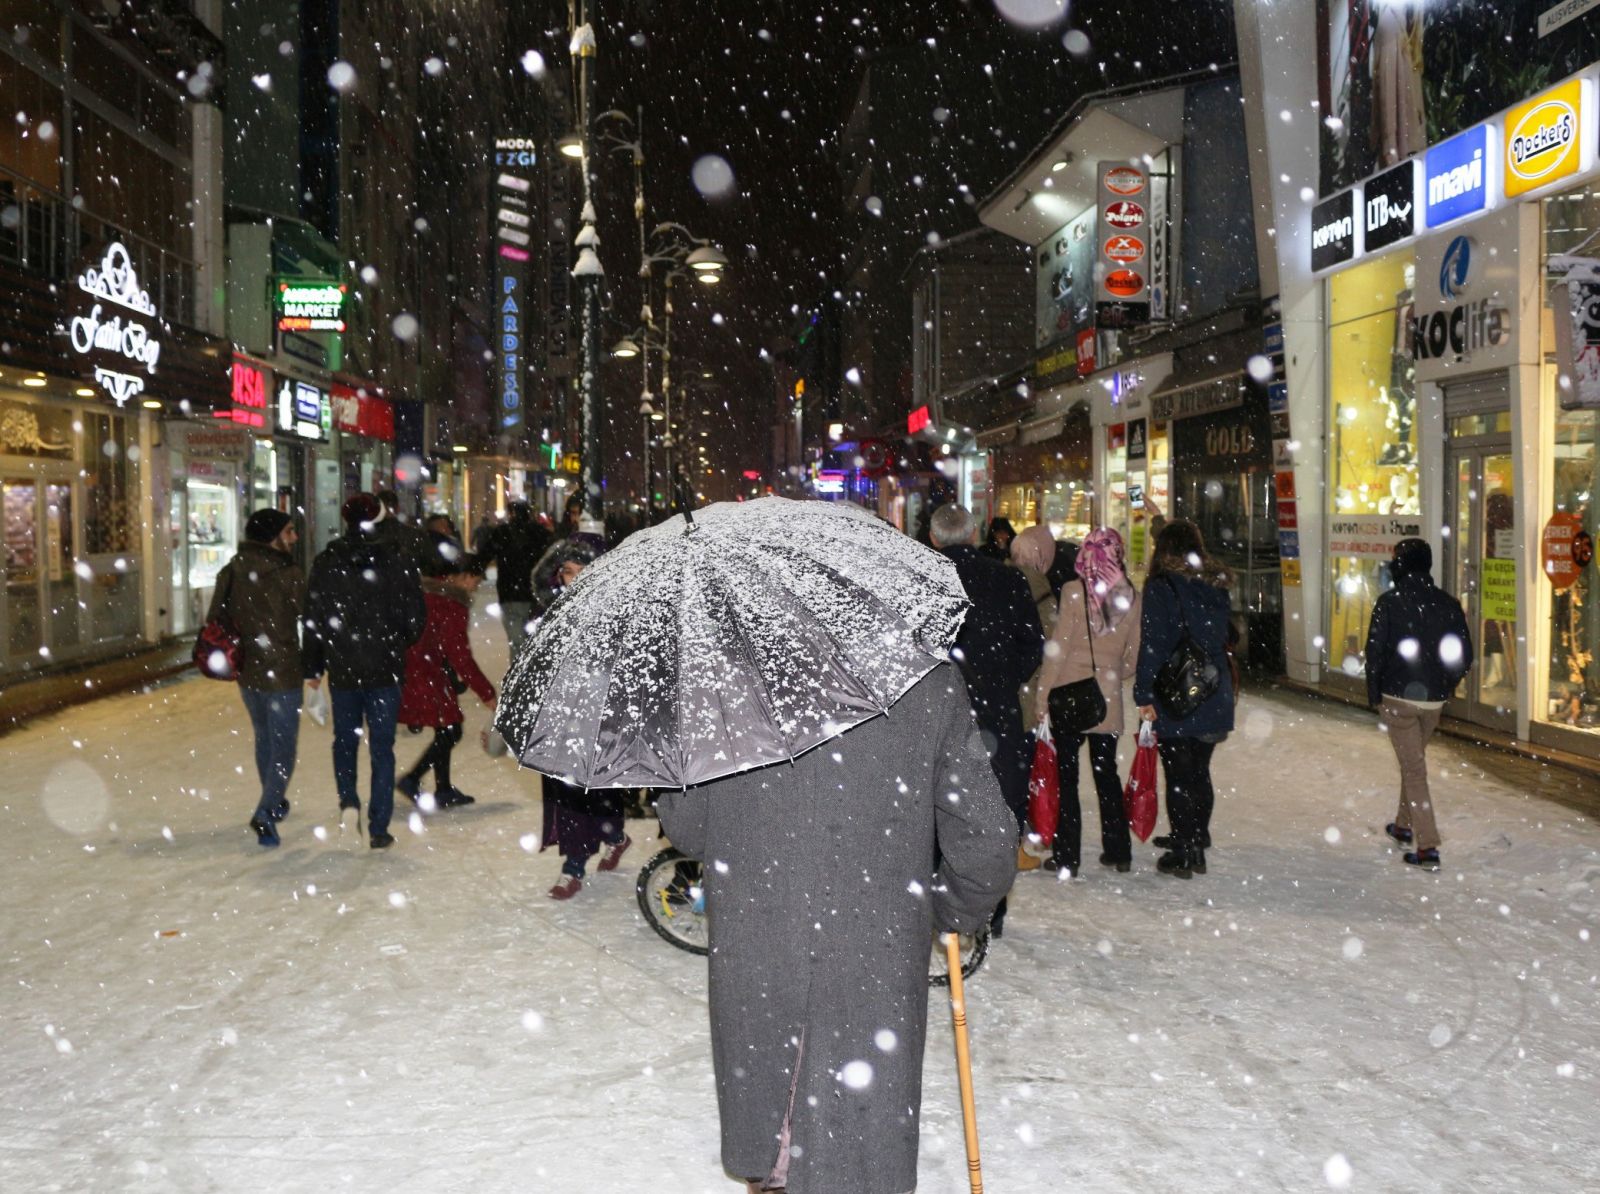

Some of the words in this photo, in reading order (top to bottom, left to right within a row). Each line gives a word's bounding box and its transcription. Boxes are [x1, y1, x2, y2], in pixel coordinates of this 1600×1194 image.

[495, 138, 536, 149] MODA
[1429, 148, 1482, 206] mavi
[1105, 211, 1144, 222] Polaris
[284, 303, 341, 317] MARKET
[1543, 525, 1572, 539] ERKEK
